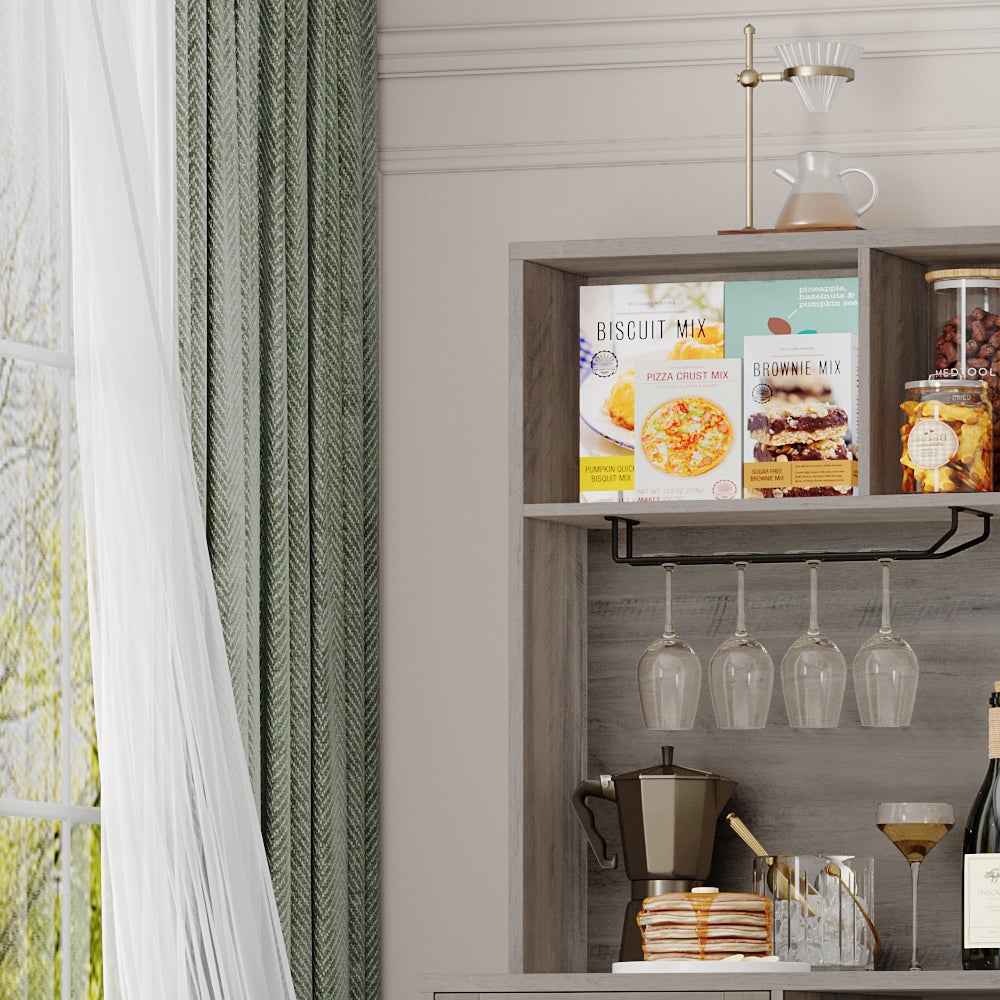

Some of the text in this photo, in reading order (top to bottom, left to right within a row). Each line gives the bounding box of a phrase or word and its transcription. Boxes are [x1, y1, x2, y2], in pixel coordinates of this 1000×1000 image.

[597, 318, 706, 341] BISCUIT MIX
[753, 360, 841, 377] BROWNIE MIX
[647, 370, 729, 382] PIZZA CRUST MIX
[585, 466, 615, 474] PUMPKIN
[591, 474, 631, 482] BISQUIT MIX
